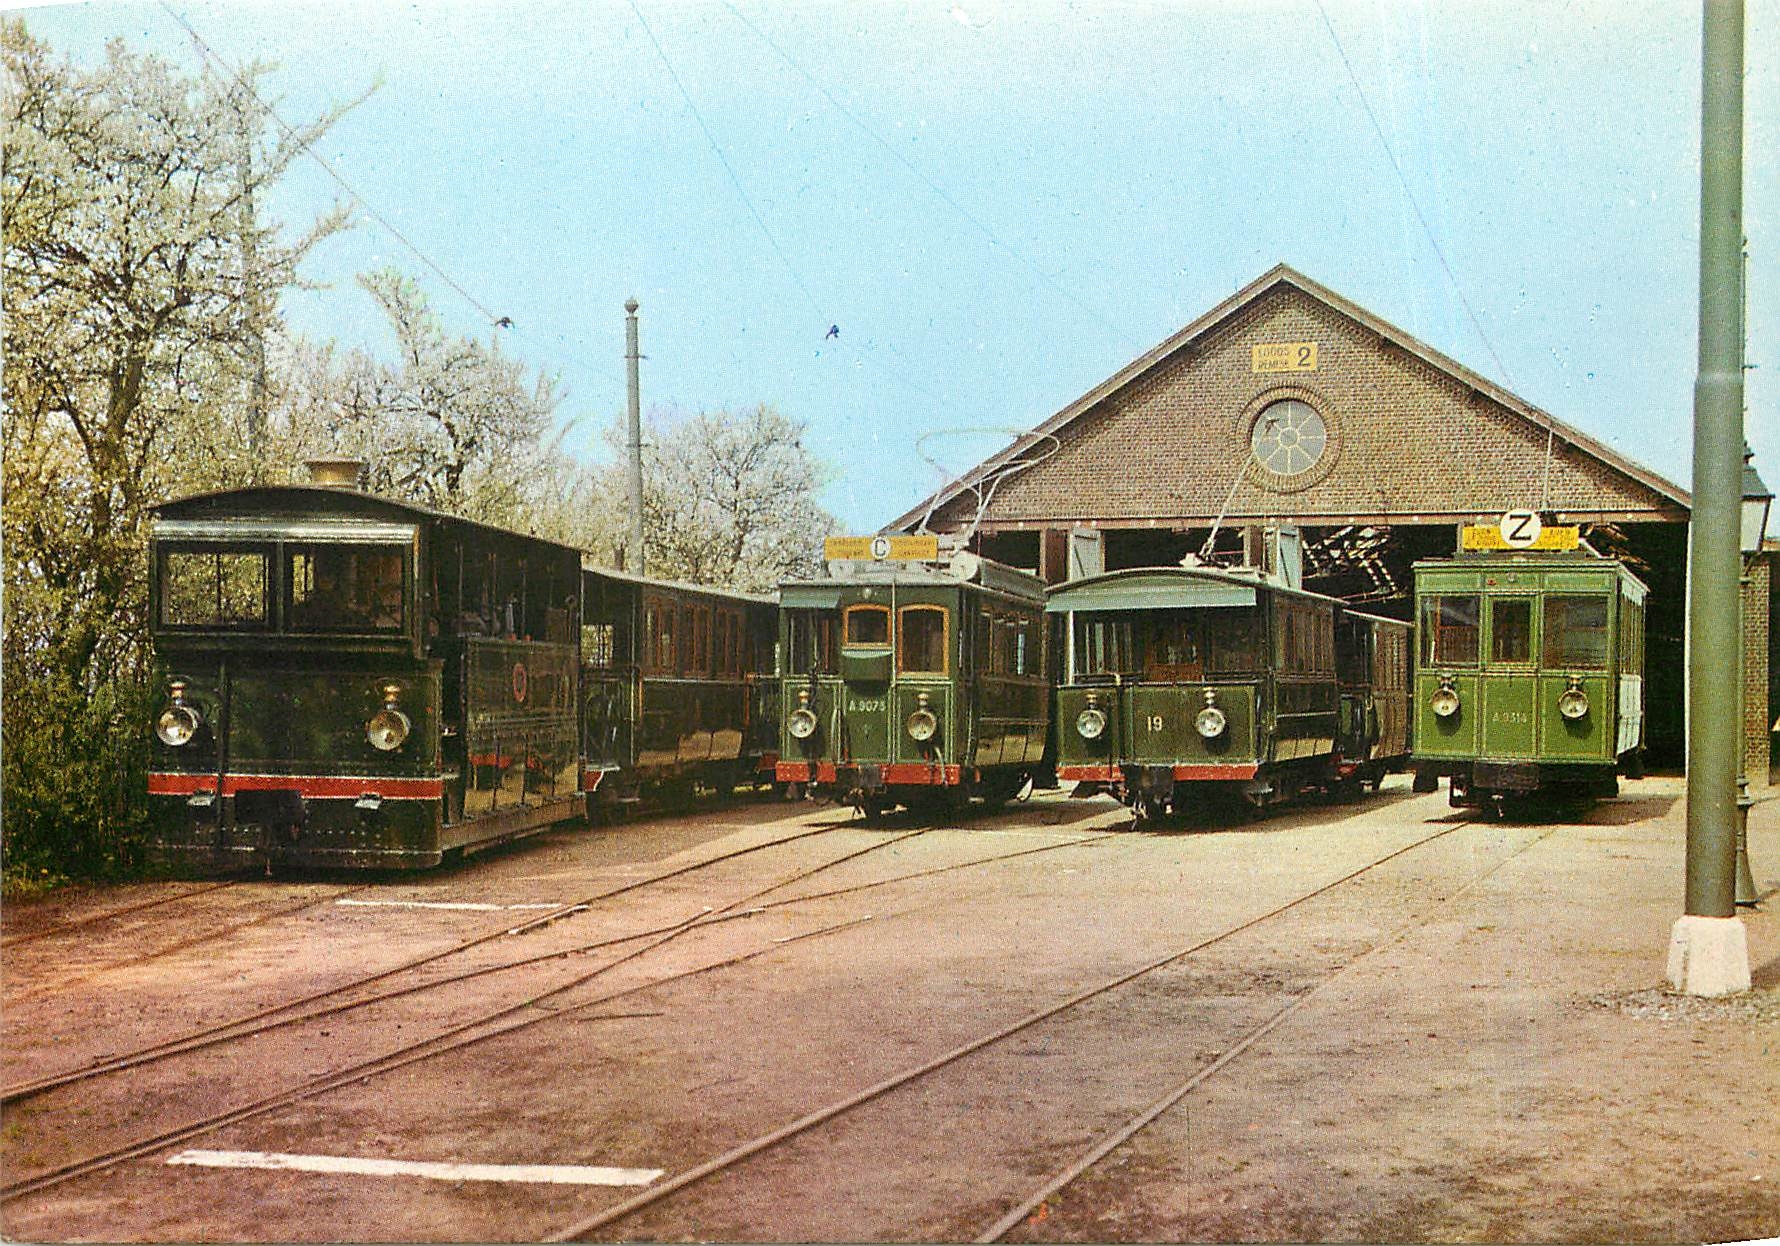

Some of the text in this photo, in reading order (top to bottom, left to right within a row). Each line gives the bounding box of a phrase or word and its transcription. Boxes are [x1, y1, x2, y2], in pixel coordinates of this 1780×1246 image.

[1297, 346, 1312, 367] 2
[1509, 513, 1533, 541] Z
[874, 539, 887, 557] C
[1147, 716, 1163, 732] 19
